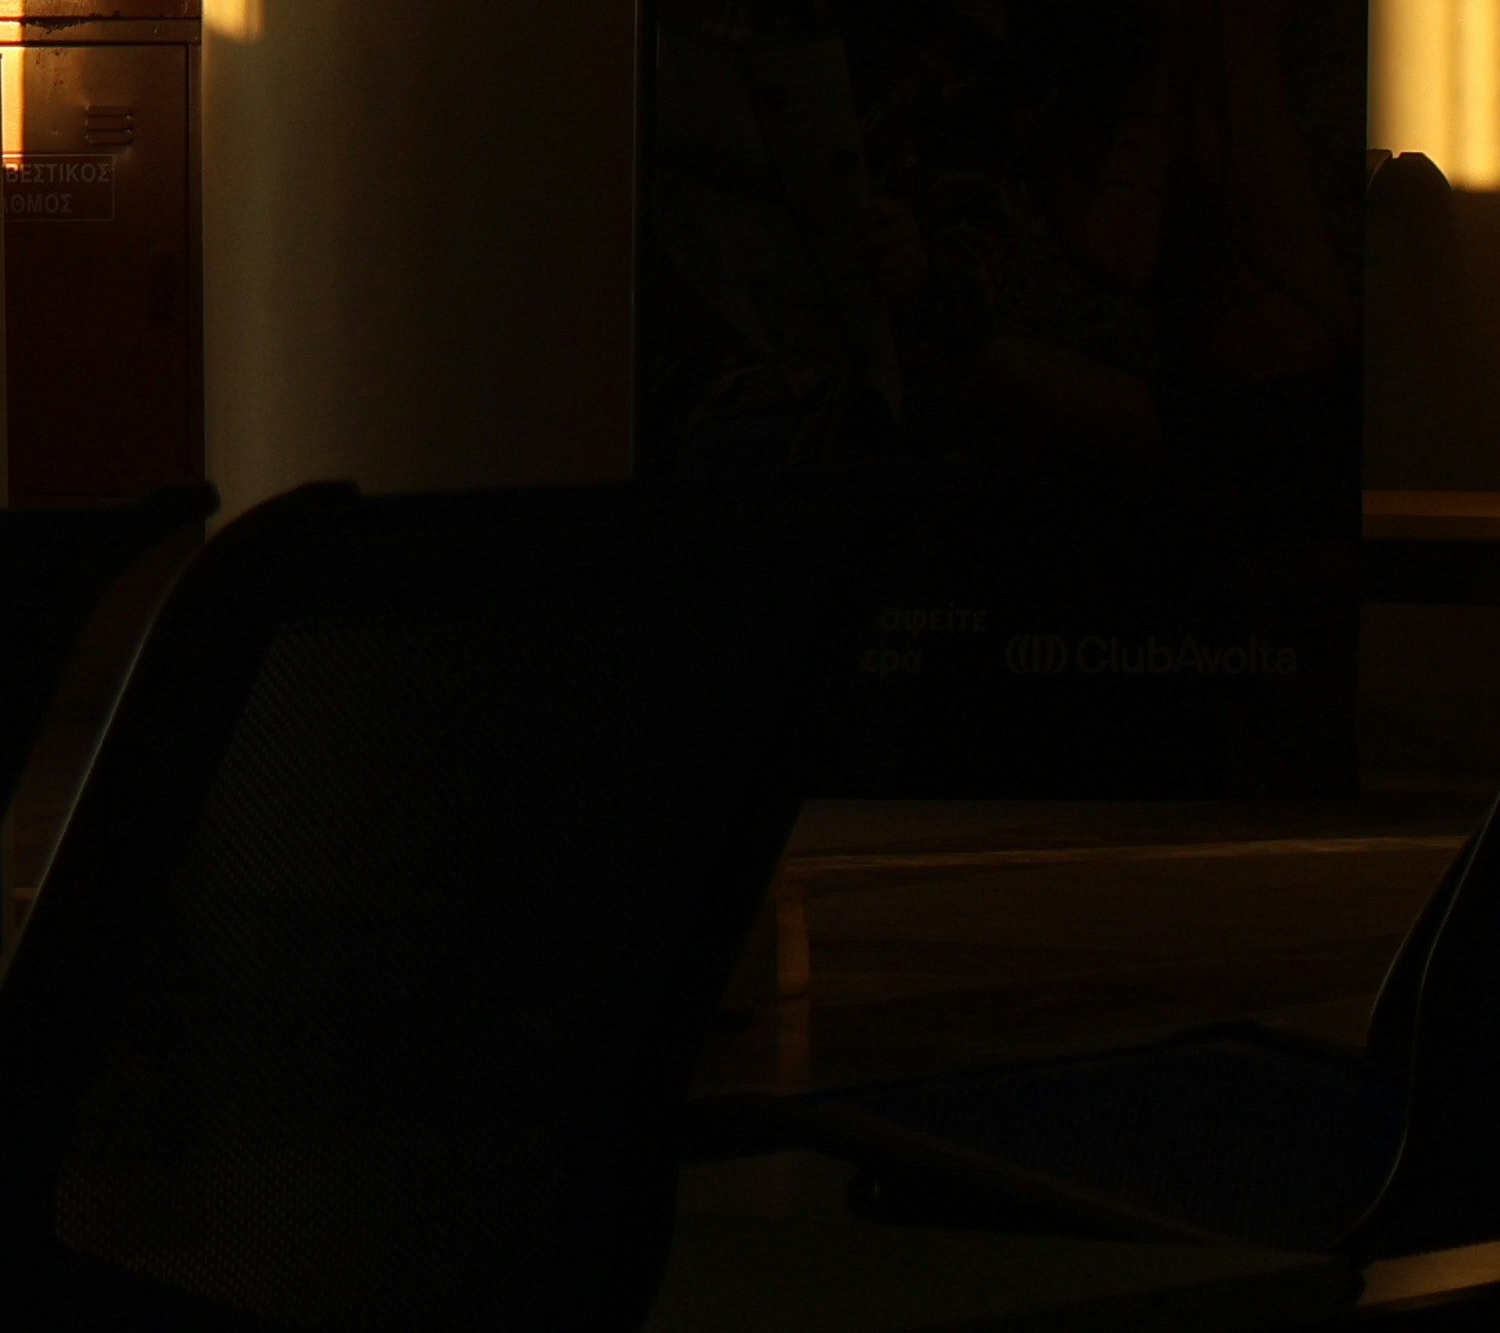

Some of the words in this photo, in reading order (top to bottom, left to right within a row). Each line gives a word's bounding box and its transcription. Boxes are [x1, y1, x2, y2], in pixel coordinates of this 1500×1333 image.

[5, 162, 110, 183] ΒΕΣΤΙΚΟΣ
[5, 193, 73, 214] ΘΜΟΣ
[879, 600, 988, 638] αφείτε
[1075, 634, 1299, 676] ClubAvolta
